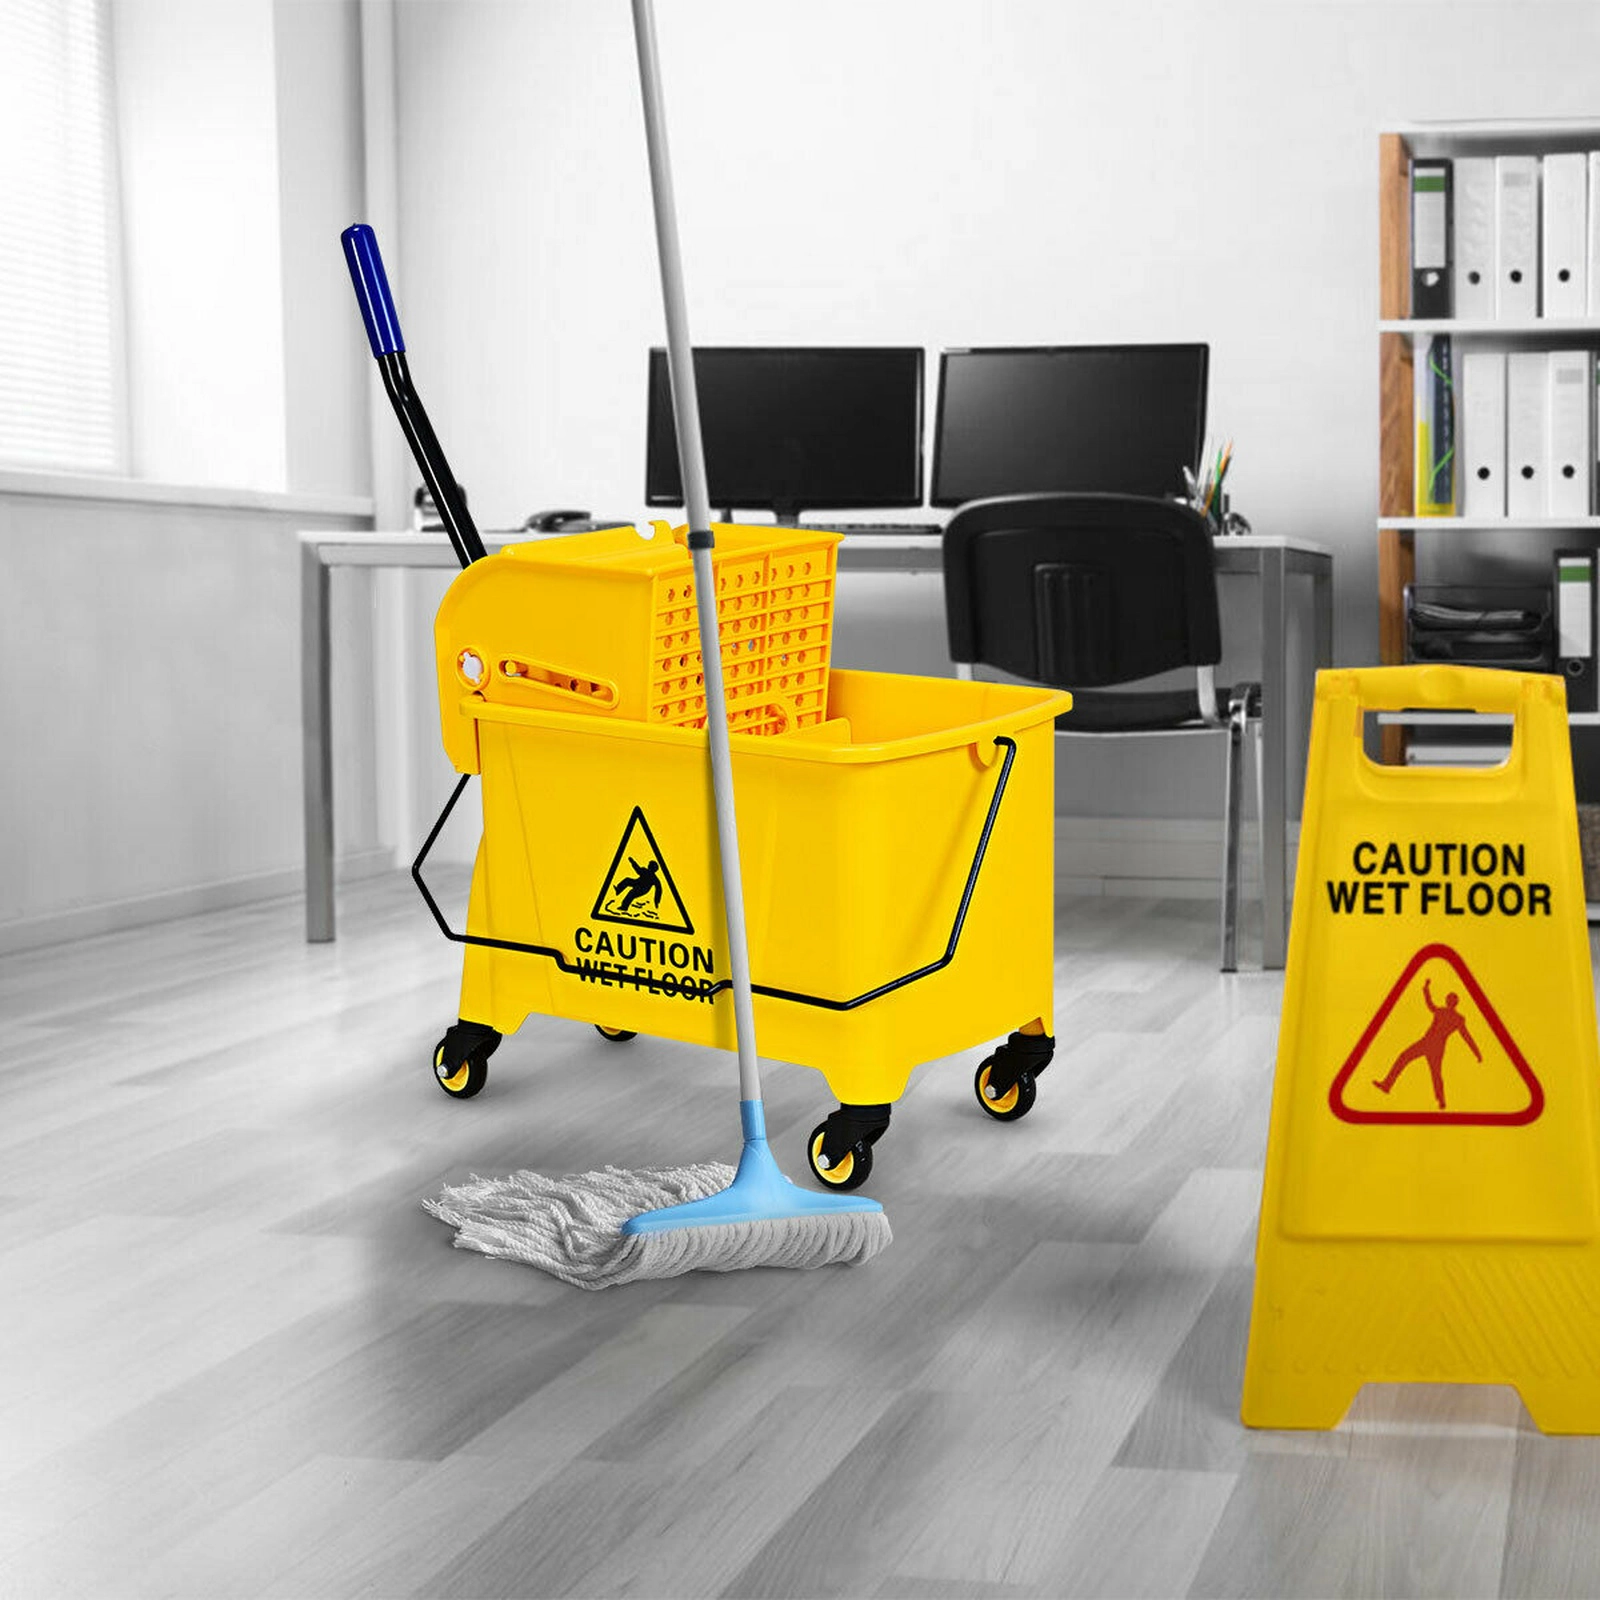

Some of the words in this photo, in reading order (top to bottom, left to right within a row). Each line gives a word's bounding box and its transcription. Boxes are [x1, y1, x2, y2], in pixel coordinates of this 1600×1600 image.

[1353, 841, 1525, 876] CAUTION
[1327, 881, 1409, 915] WET
[1421, 882, 1552, 916] FLOOR
[575, 927, 714, 974] CAUTION
[576, 957, 628, 988] WET
[634, 967, 714, 1005] FLOOR
